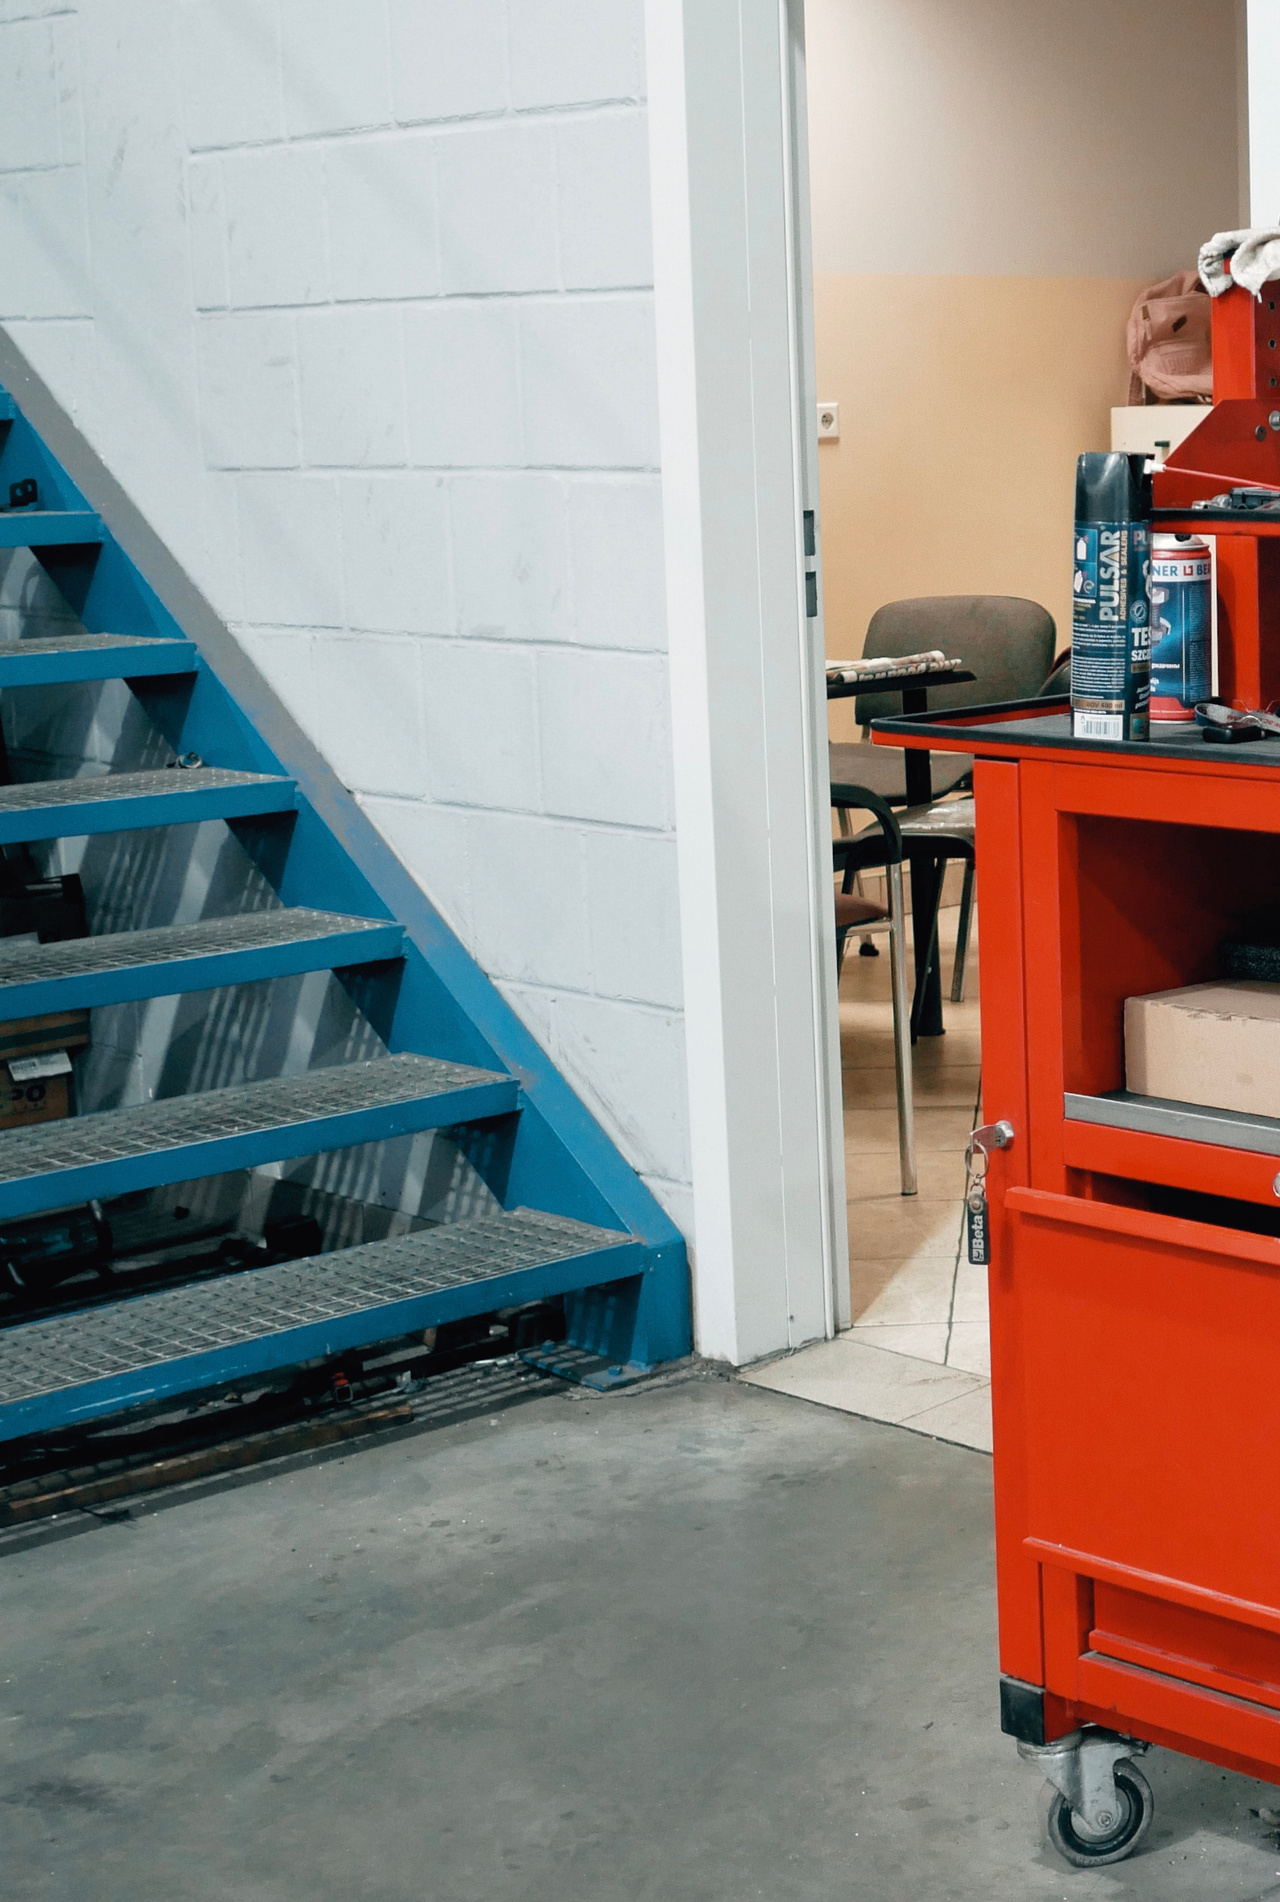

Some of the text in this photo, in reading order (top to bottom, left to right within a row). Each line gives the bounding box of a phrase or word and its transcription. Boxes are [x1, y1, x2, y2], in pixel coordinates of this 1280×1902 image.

[1120, 530, 1128, 566] SEALERS
[1099, 531, 1120, 621] PULSAR
[971, 1215, 984, 1248] Beta
